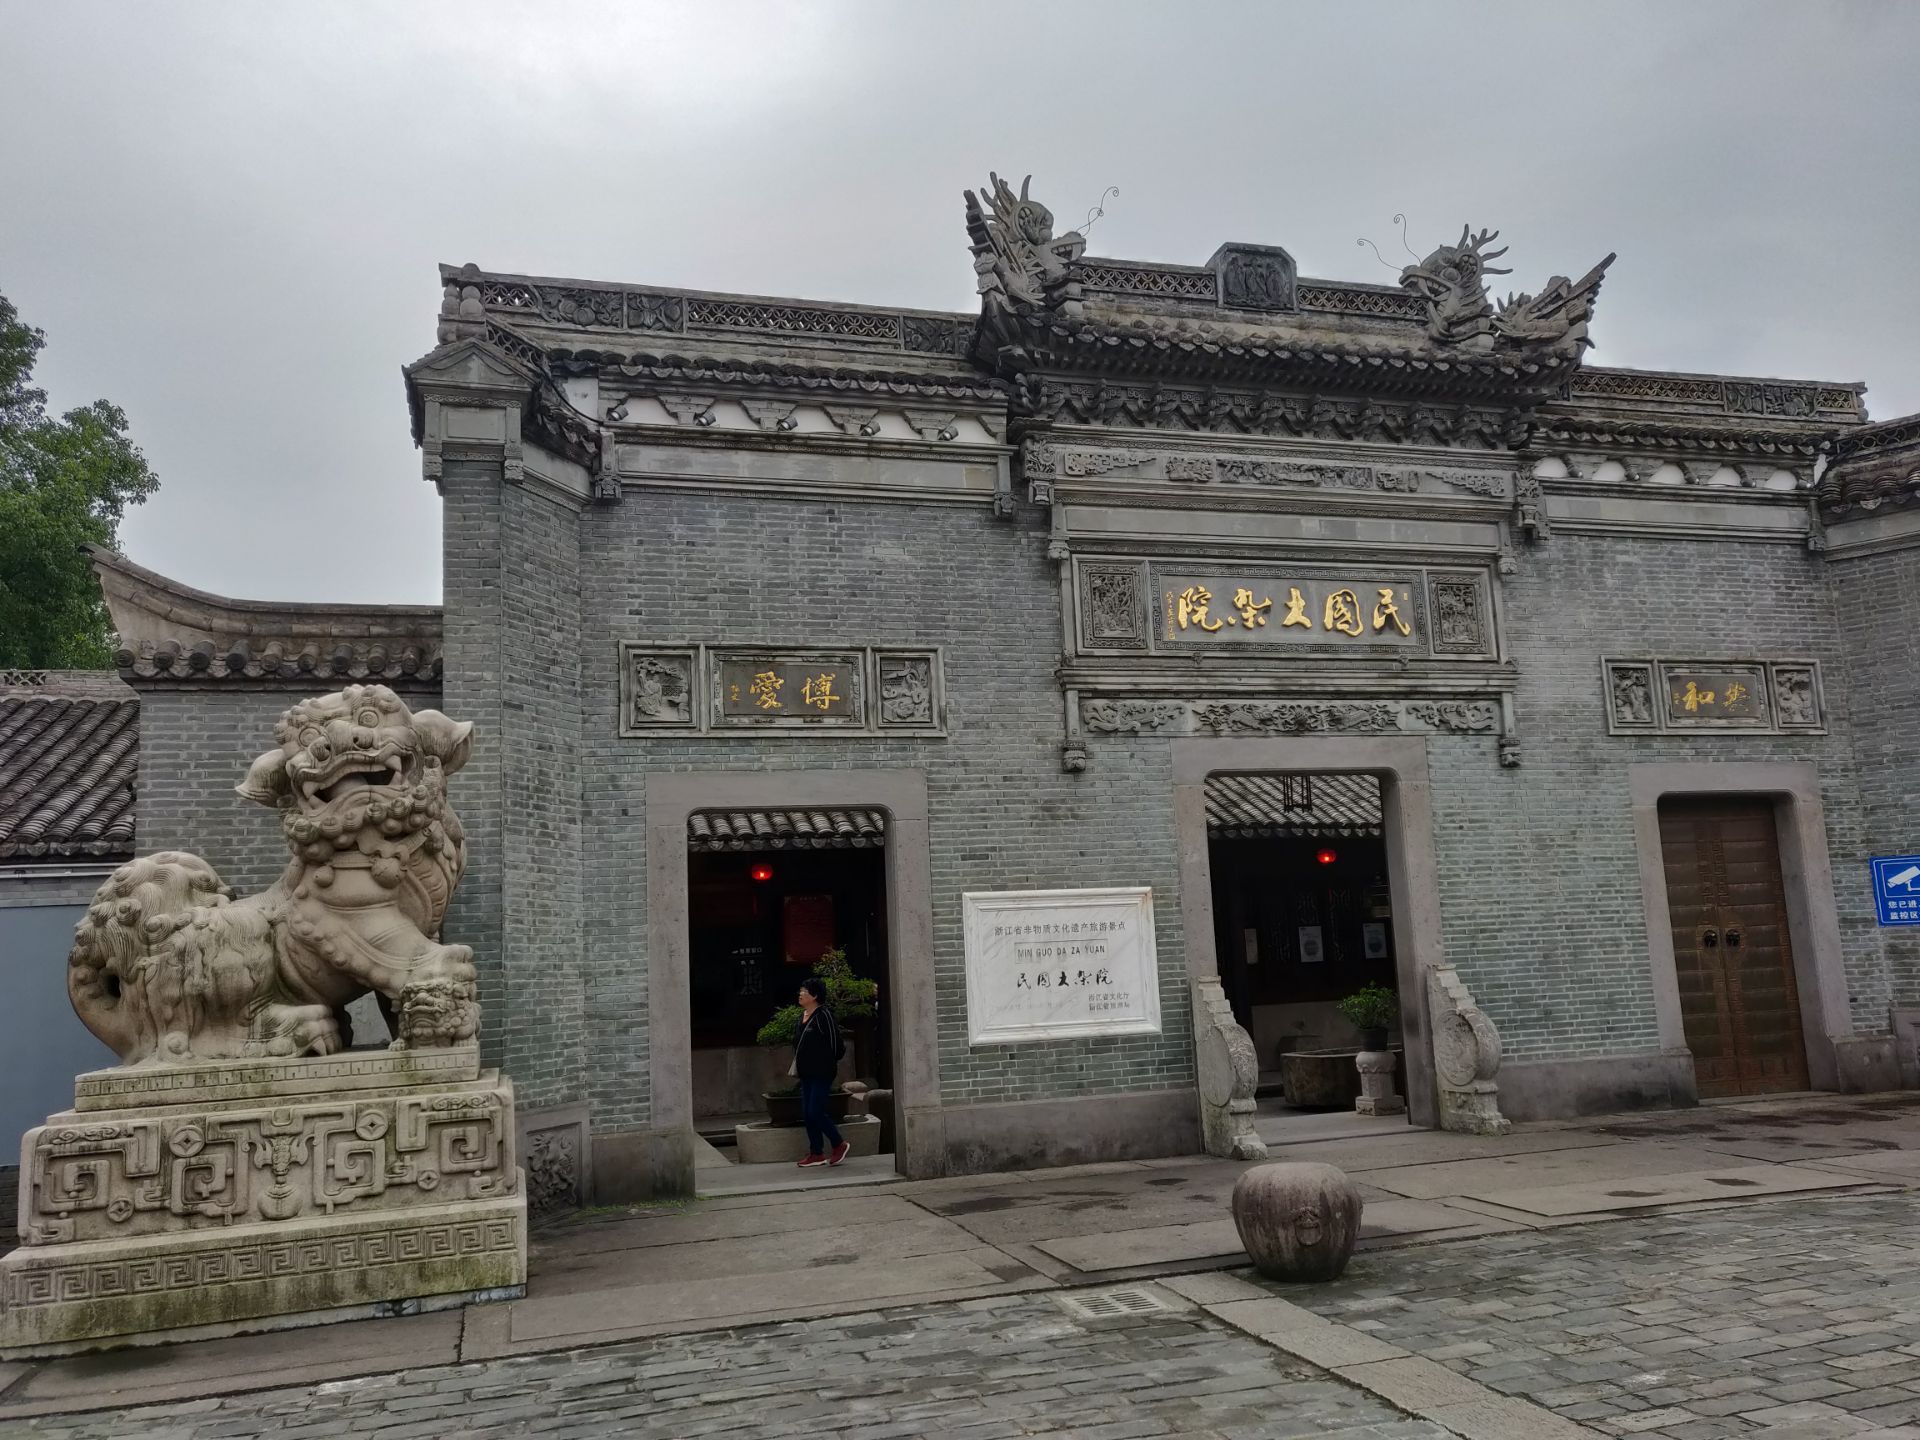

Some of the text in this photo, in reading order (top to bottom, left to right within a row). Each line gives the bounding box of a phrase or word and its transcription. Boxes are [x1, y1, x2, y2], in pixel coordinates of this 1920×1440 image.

[1888, 900, 1920, 909] 您已进
[1890, 911, 1920, 920] 监控区
[994, 921, 1126, 937] 浙江省非物质文化遗产旅游景点
[1017, 945, 1105, 959] MIN GUO DA ZA YUAN
